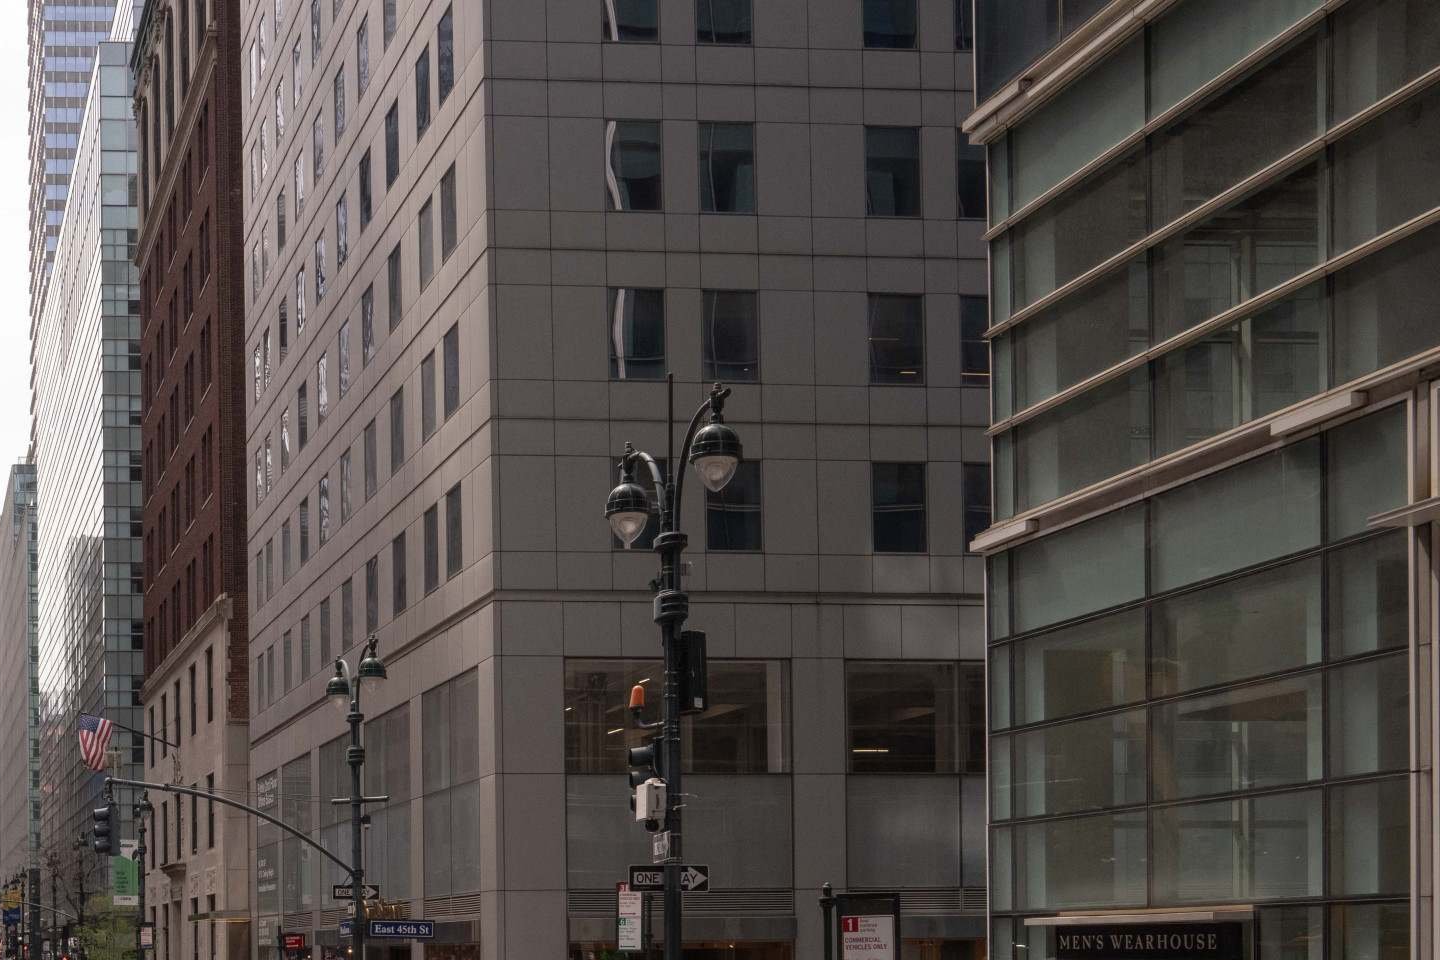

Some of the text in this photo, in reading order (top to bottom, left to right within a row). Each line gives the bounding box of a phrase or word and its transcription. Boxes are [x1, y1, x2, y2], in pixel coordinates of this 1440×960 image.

[636, 873, 698, 883] ONE AY
[374, 924, 429, 934] East 45th St
[847, 918, 854, 931] 1
[1059, 933, 1217, 950] MEN'S WEARHOUSE
[845, 943, 871, 951] VEHICLES
